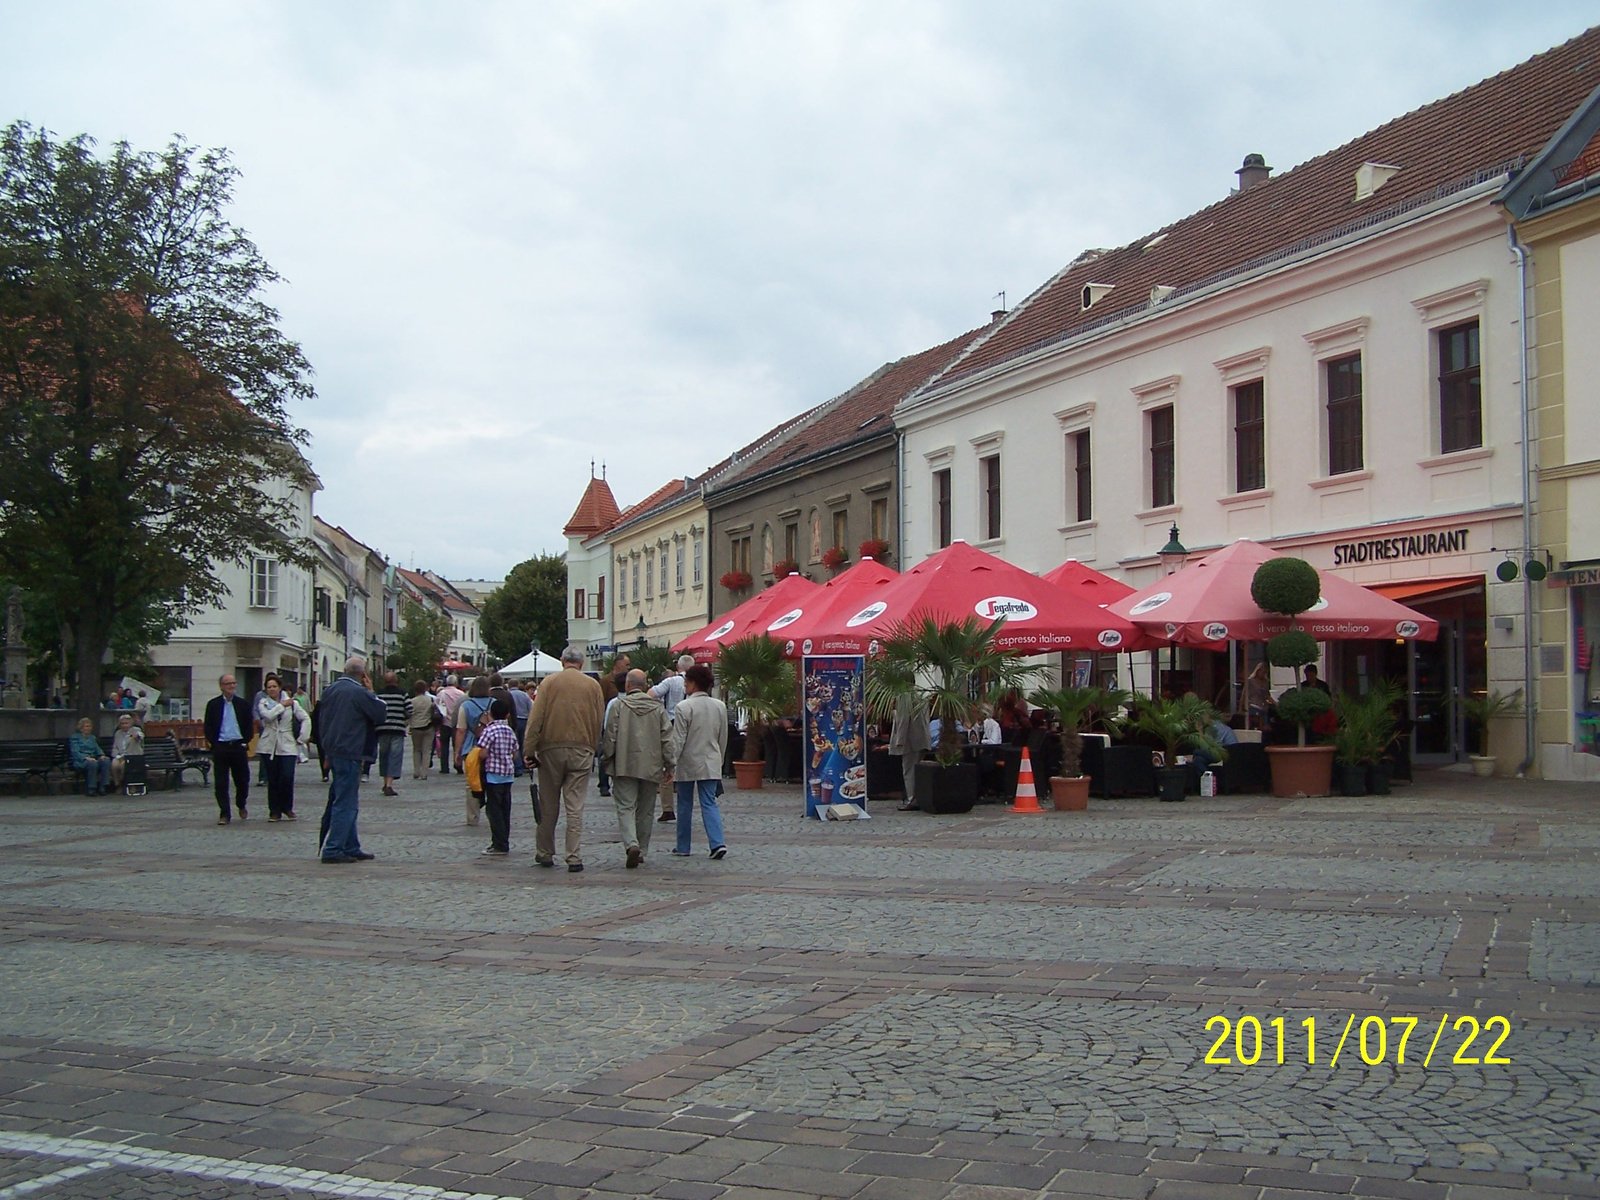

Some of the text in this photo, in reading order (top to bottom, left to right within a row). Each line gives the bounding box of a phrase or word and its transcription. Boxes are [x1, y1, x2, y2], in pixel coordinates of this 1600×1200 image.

[1334, 529, 1469, 565] STADTRESTAURANT
[986, 601, 1030, 616] Segafredo
[1337, 621, 1370, 633] italiano
[999, 635, 1037, 647] espresso
[1039, 632, 1072, 644] italiano
